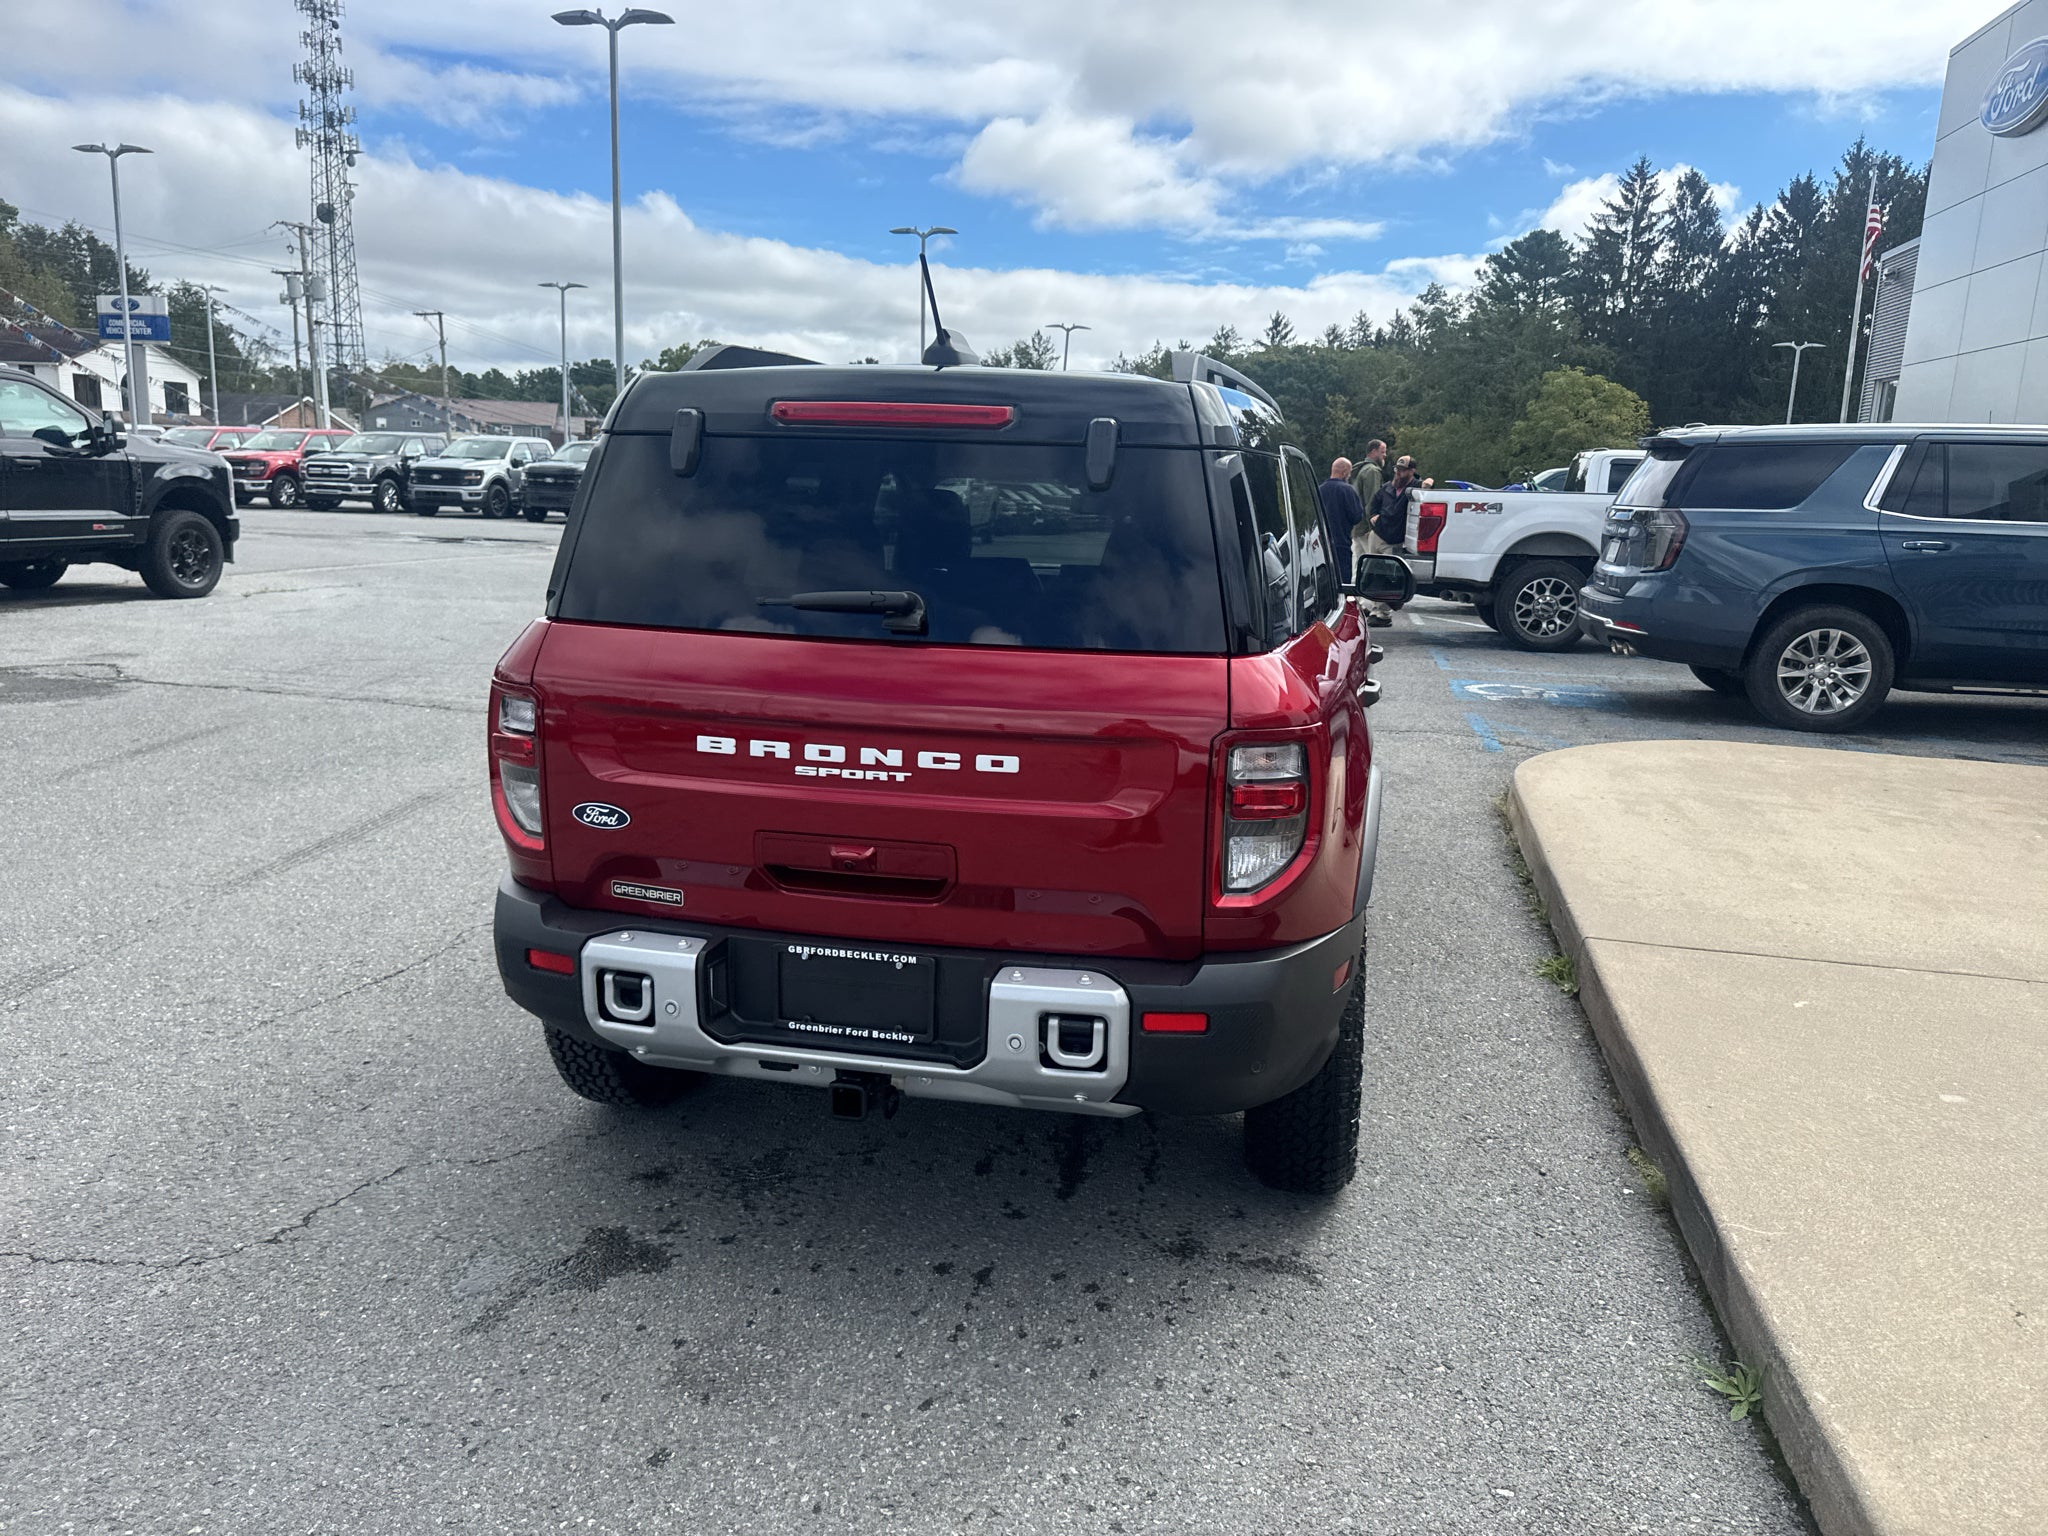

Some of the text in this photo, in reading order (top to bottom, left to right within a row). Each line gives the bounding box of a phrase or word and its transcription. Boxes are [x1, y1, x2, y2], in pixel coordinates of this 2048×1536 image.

[1990, 58, 2042, 121] Ford
[105, 327, 127, 335] VEHICL
[1454, 501, 1503, 513] FX4
[696, 735, 1020, 773] BRONCO
[794, 765, 912, 782] SPORT
[583, 806, 619, 826] Ford
[613, 884, 682, 903] GREENBRIER
[787, 945, 918, 964] GBRFORDBECKLEY.COM
[788, 1021, 915, 1044] Greenbrier Ford Beckley
